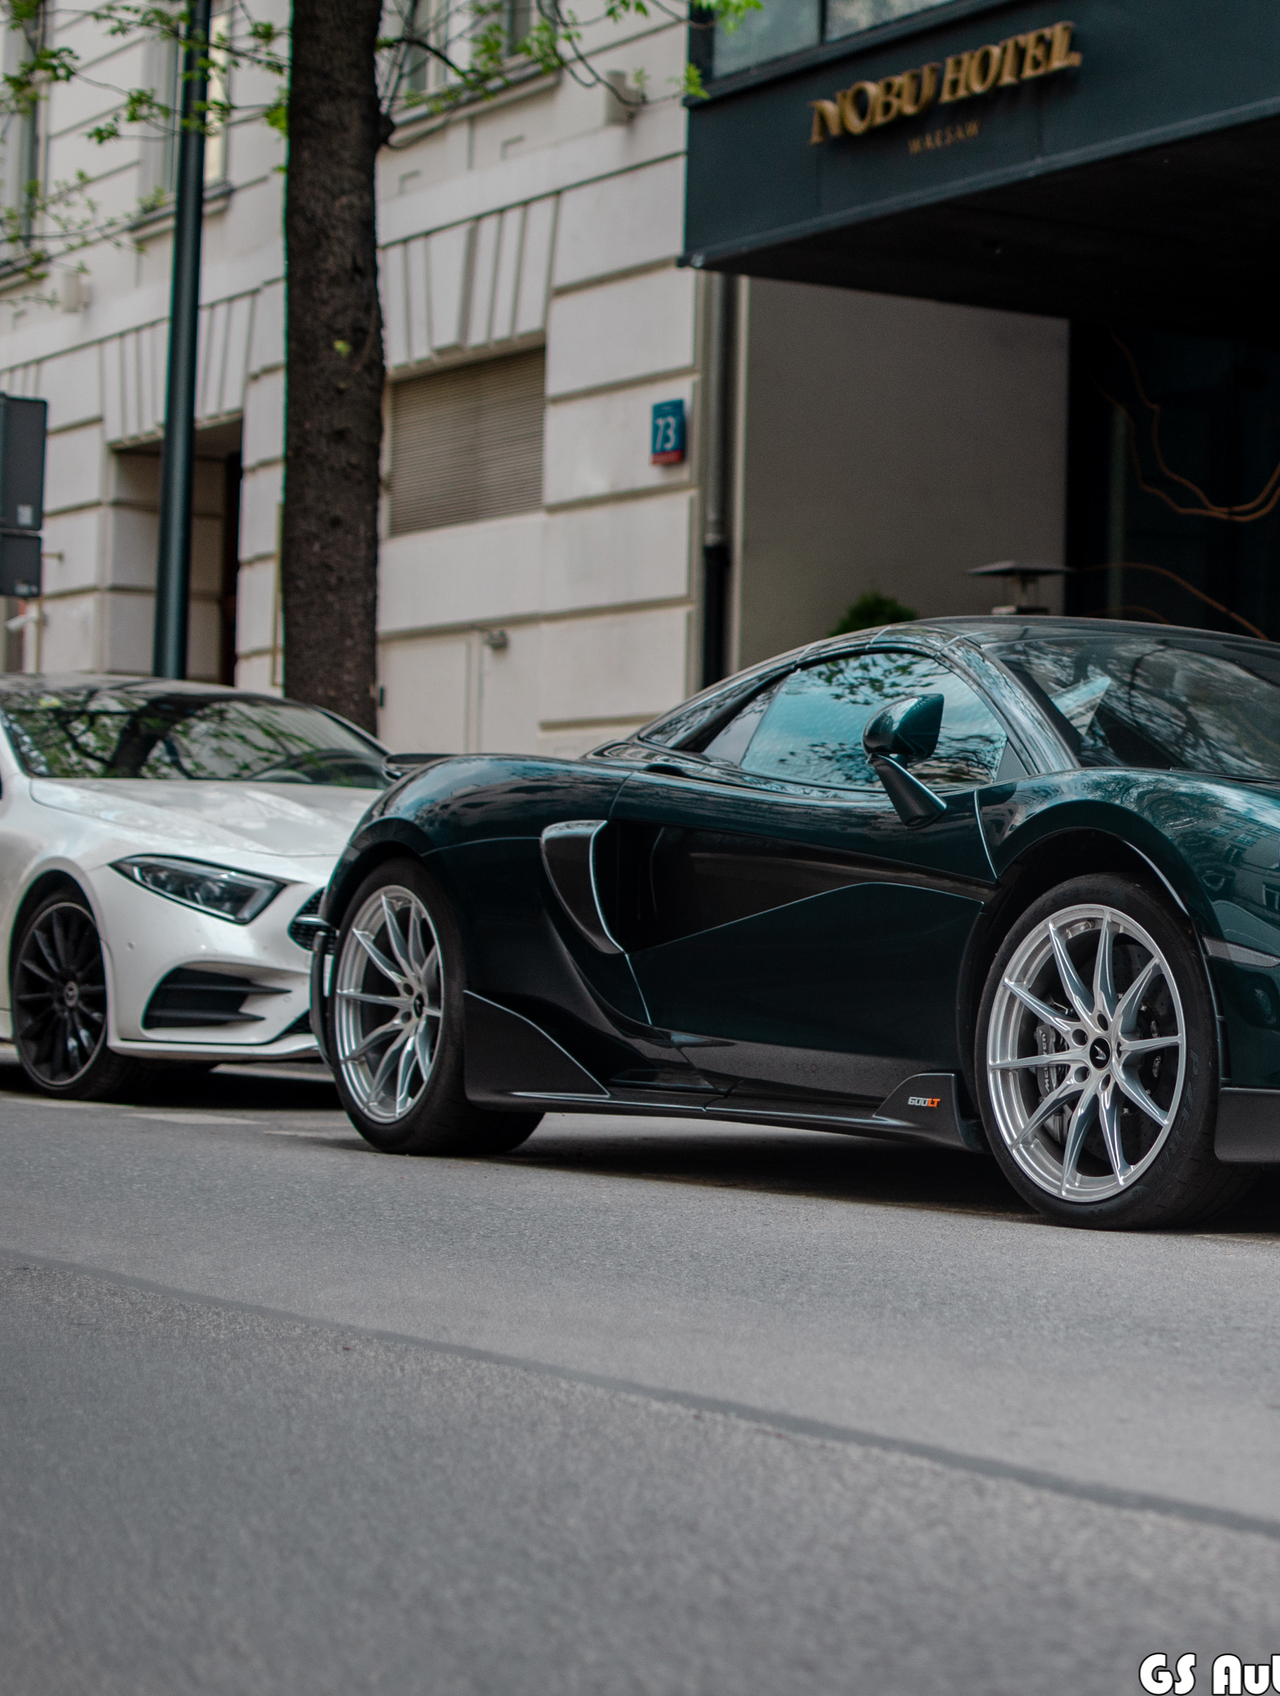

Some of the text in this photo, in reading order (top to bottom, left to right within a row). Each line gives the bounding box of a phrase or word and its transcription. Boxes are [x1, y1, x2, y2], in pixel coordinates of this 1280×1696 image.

[809, 20, 1082, 145] NOBU HOTEL
[655, 416, 676, 451] 73
[907, 1096, 941, 1108] 600LT
